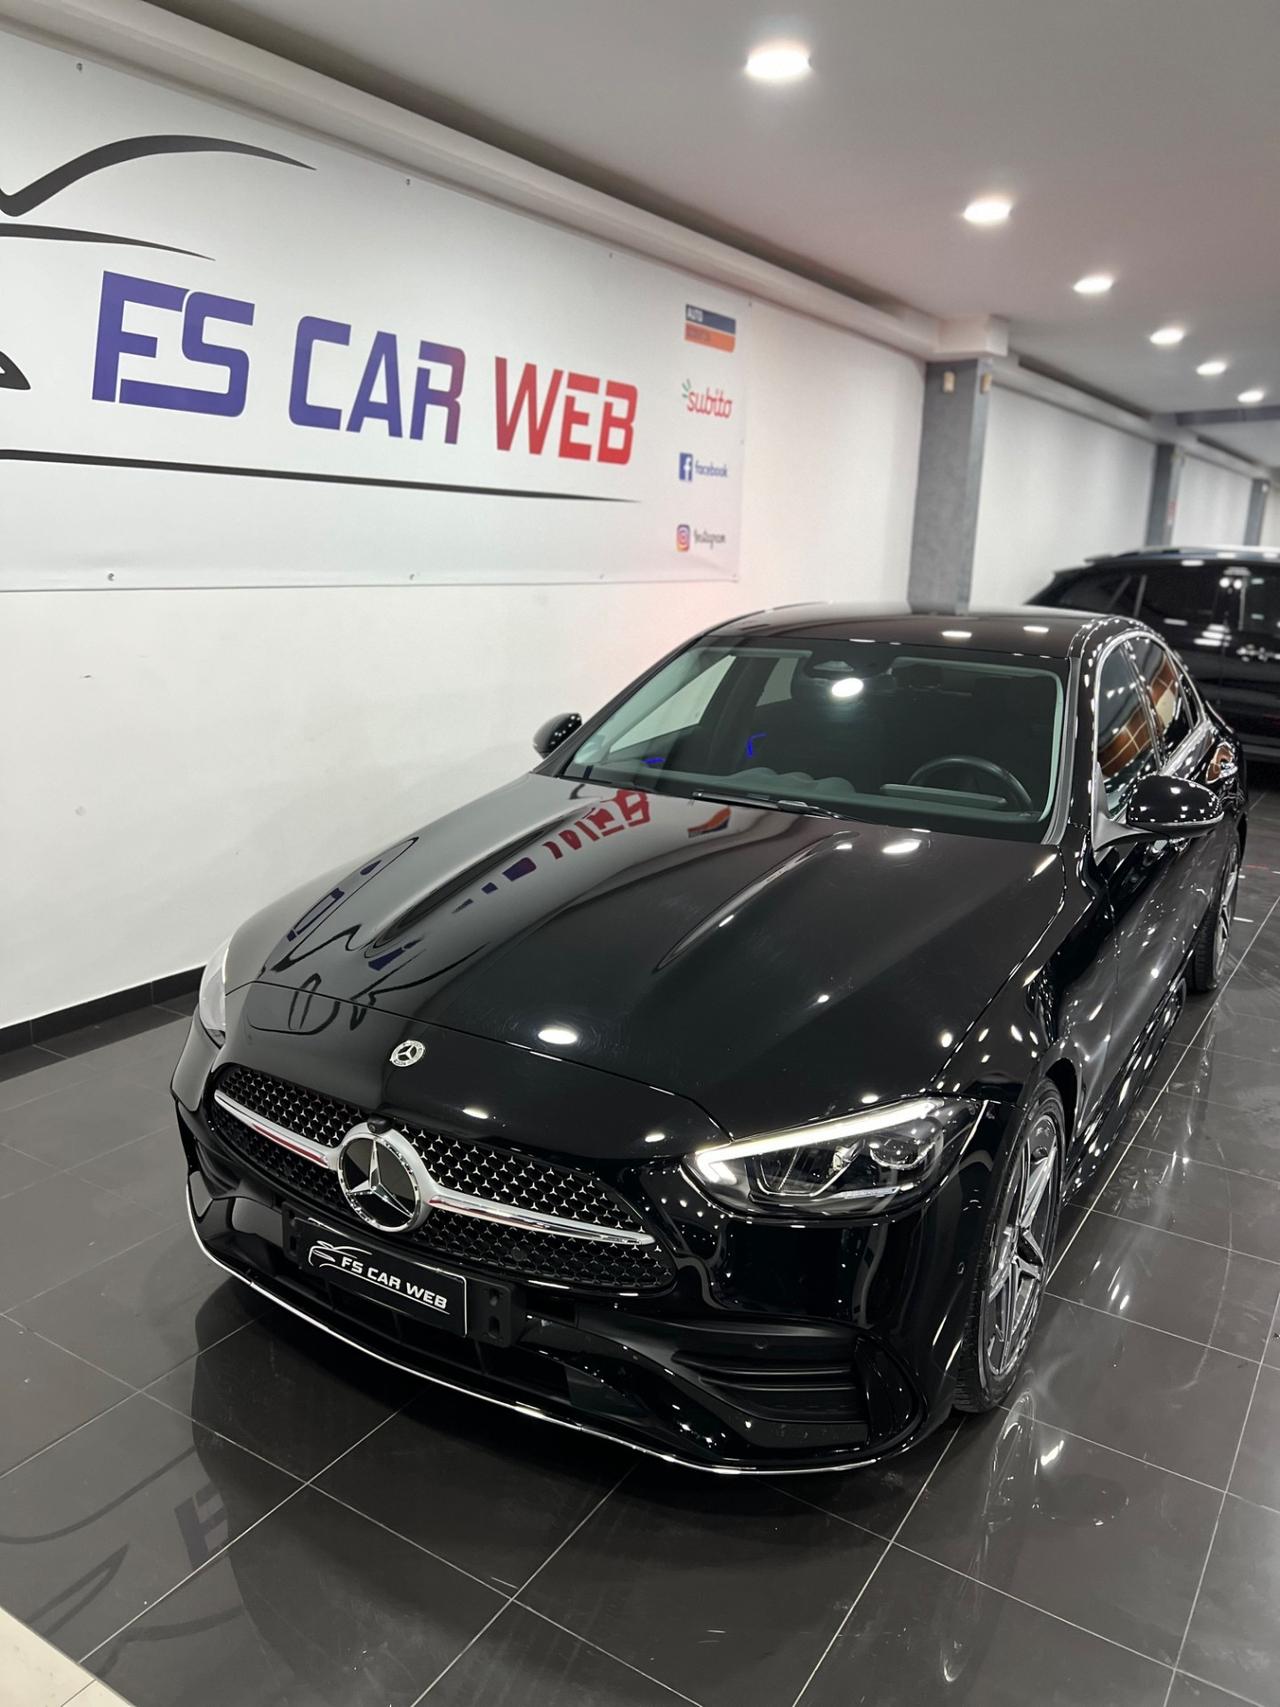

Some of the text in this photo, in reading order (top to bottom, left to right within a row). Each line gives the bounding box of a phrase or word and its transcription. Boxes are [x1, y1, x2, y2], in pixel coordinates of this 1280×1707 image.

[92, 270, 639, 466] FS CAR WEB
[687, 386, 733, 418] subito
[695, 460, 728, 478] facebook
[341, 1256, 448, 1310] FS CAR WEB
